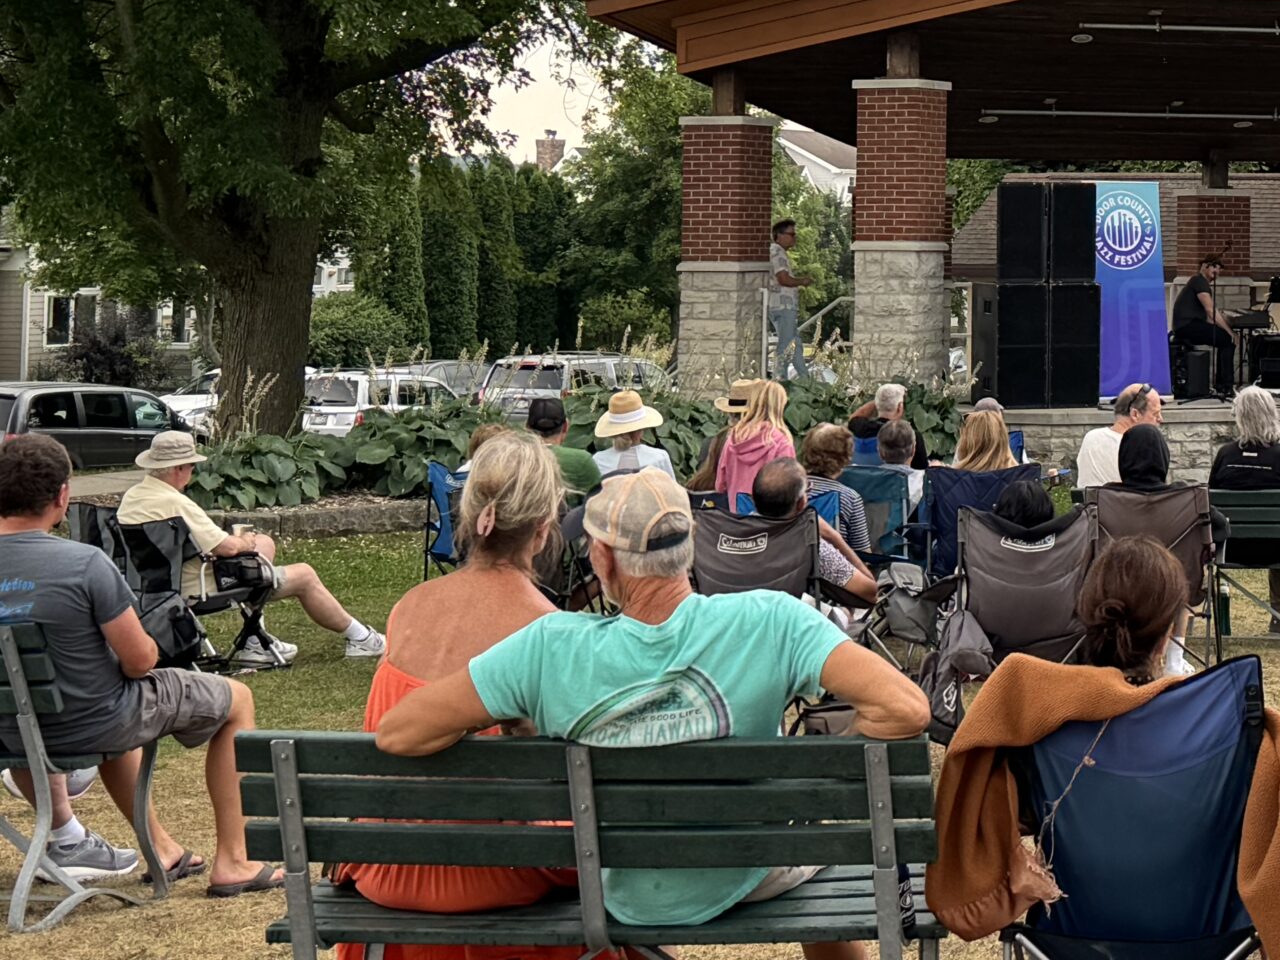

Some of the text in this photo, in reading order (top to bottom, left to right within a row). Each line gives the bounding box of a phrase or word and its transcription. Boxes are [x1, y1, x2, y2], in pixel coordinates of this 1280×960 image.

[1096, 196, 1153, 224] DOOR COUNTY
[1114, 236, 1154, 266] FESTIVAL
[678, 708, 703, 719] LIFE
